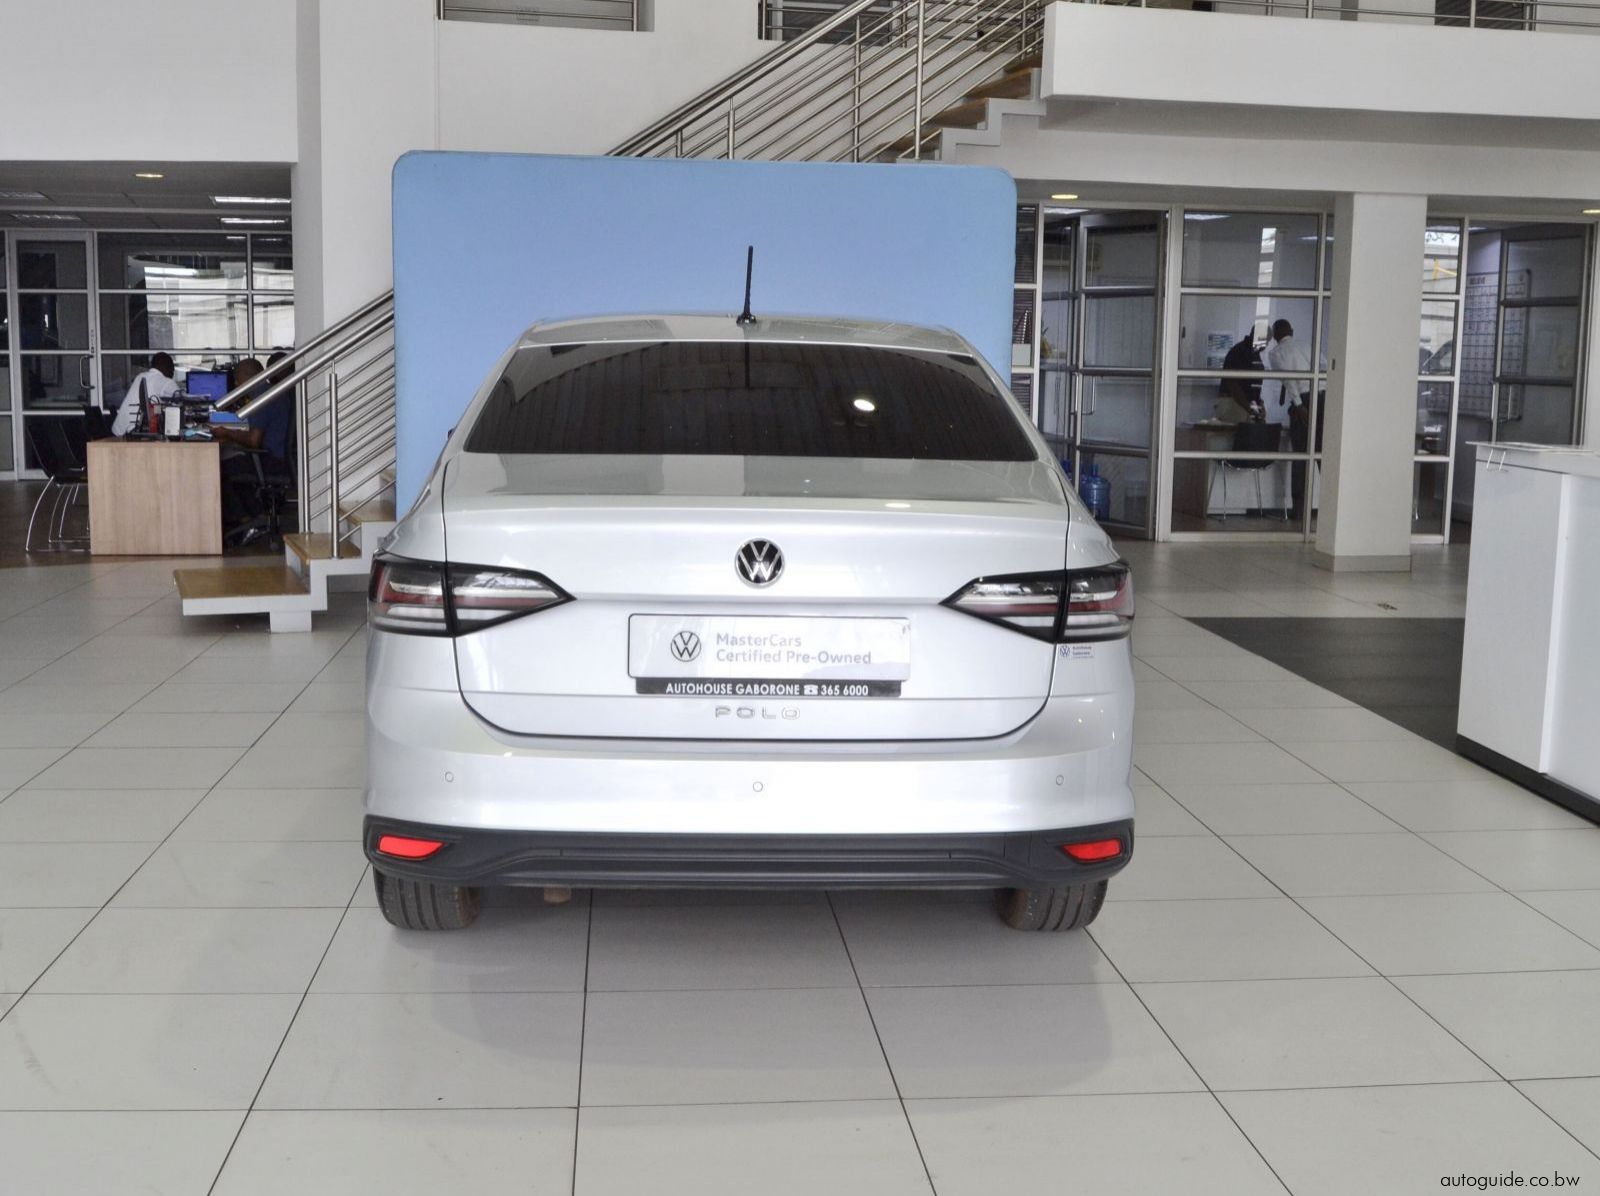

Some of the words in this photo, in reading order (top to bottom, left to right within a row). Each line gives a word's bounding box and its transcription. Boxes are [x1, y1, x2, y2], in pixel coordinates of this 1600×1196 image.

[716, 632, 802, 647] MasterCars
[716, 649, 782, 663] Certified
[786, 650, 872, 664] Pre-Owned
[665, 682, 733, 695] AUTOHOUSE
[735, 684, 800, 696] GABORONE
[820, 684, 840, 696] 365
[843, 684, 869, 696] 6000
[715, 706, 801, 721] POLO
